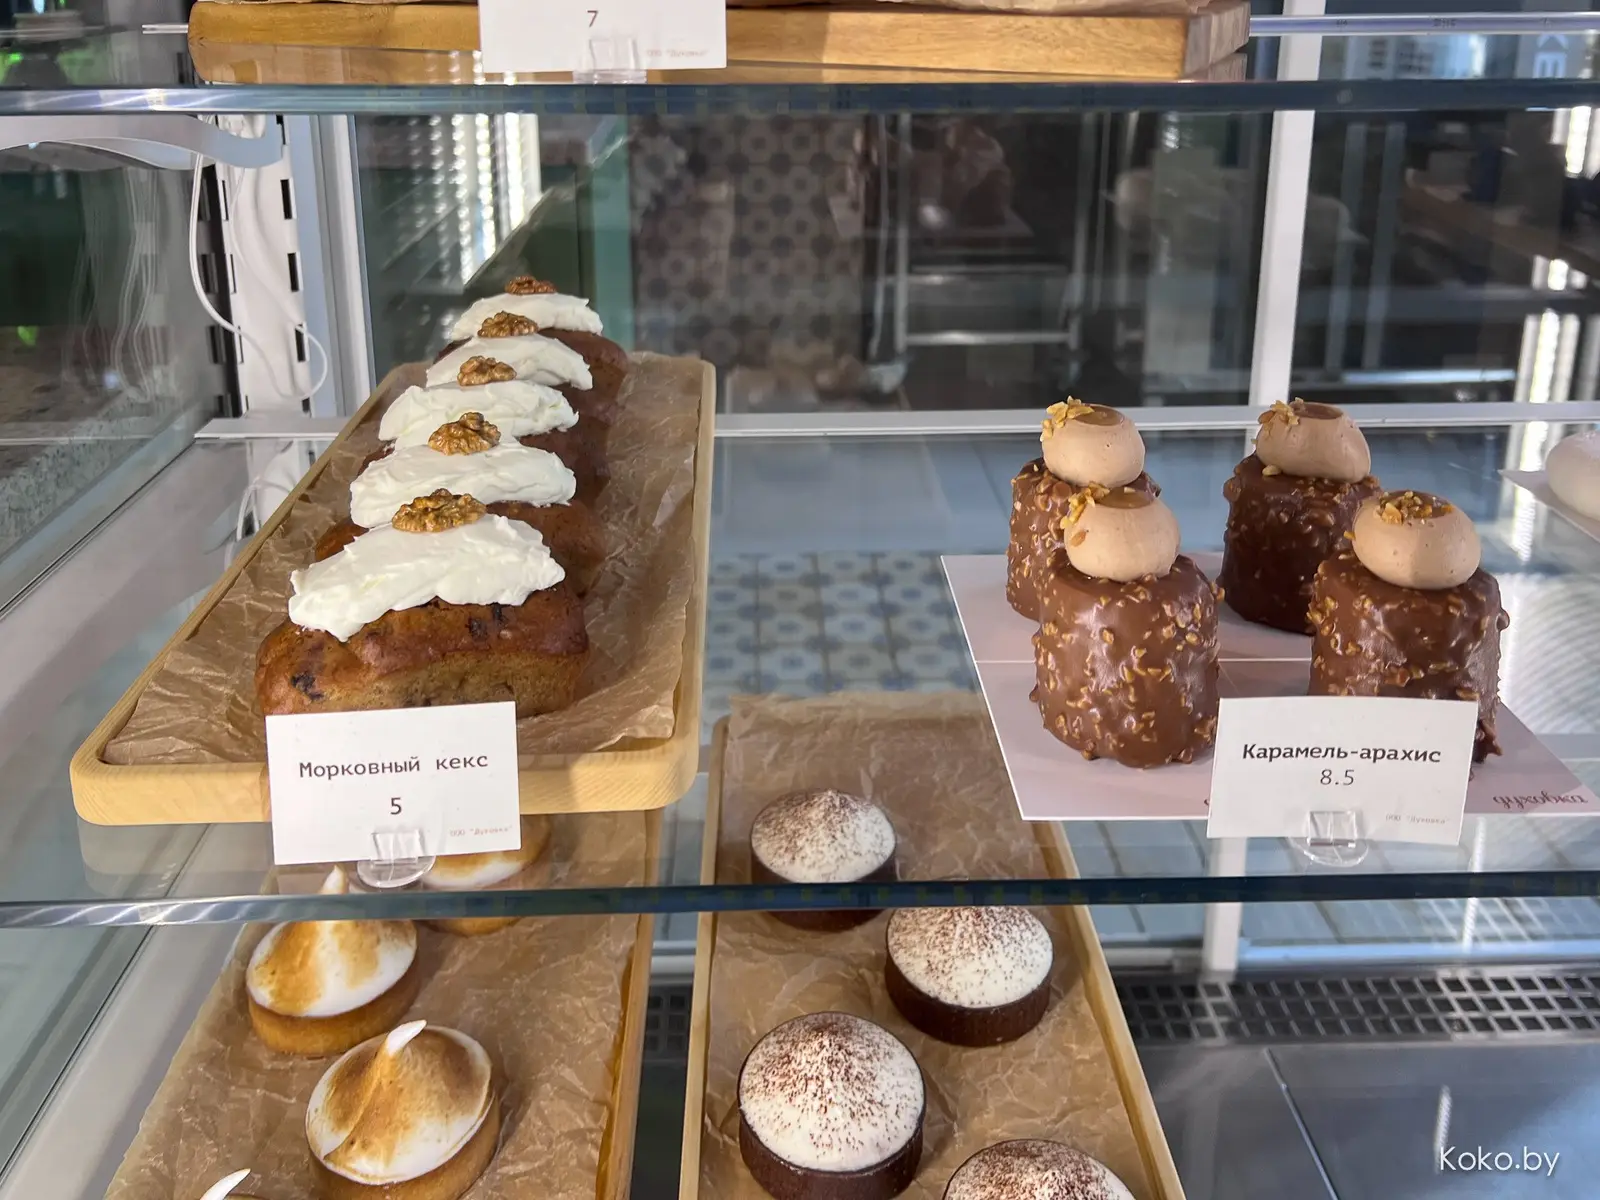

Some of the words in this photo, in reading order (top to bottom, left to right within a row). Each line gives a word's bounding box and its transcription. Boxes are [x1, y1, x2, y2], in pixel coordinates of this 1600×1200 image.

[587, 10, 598, 27] 7
[1243, 743, 1442, 763] Карамель-арахис
[299, 755, 421, 780] Морковный
[436, 755, 489, 770] кекс
[1320, 768, 1355, 786] 8.5
[389, 797, 403, 815] 5
